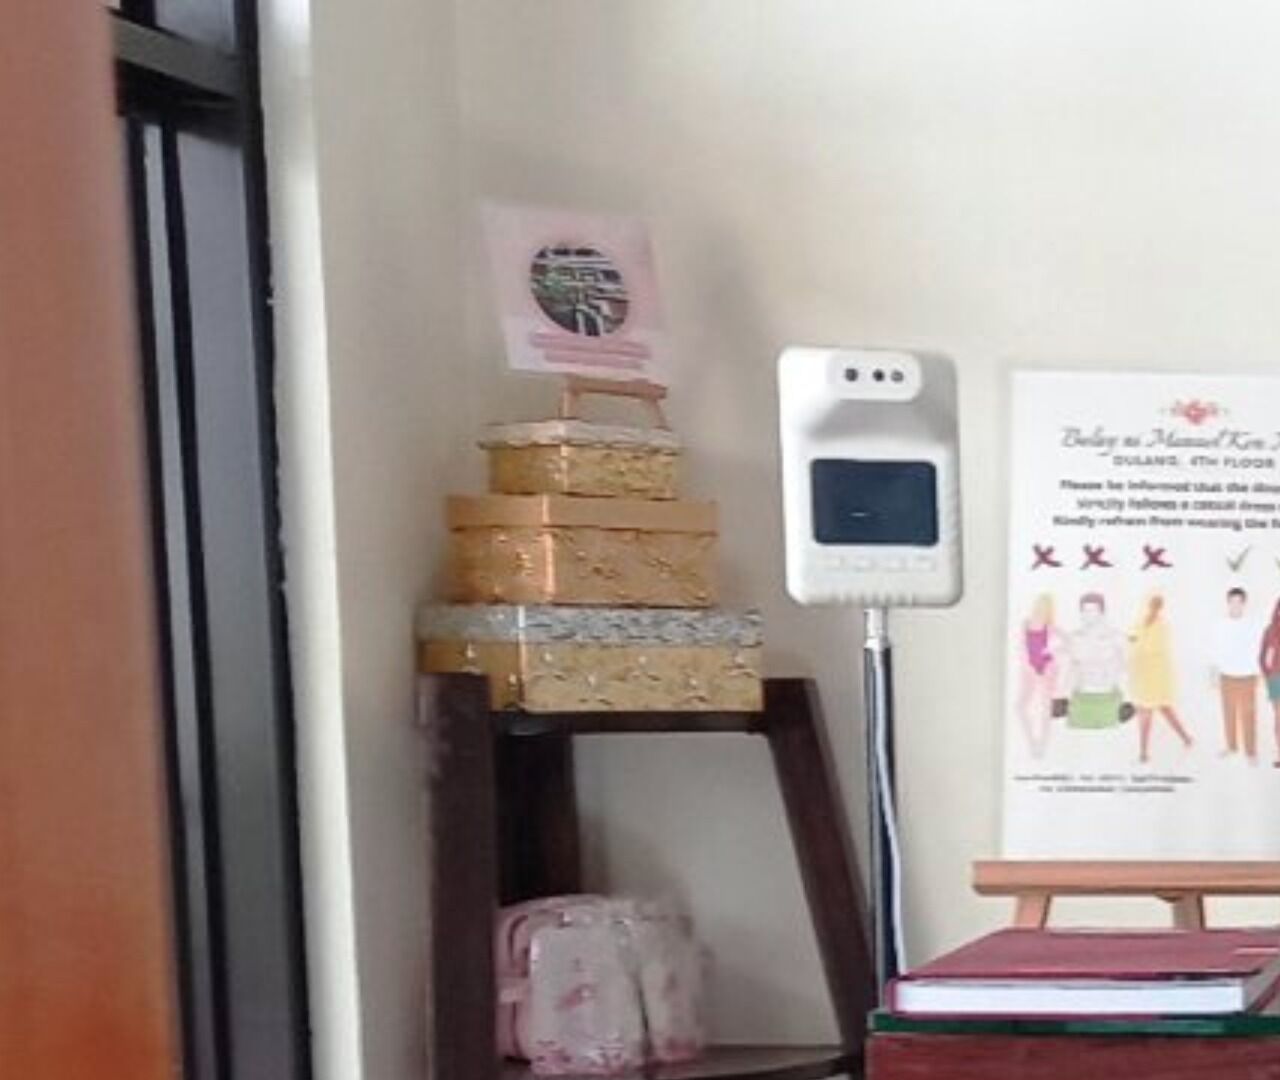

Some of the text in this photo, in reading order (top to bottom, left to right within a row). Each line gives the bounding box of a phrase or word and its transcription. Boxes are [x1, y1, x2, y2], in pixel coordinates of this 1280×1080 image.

[1224, 457, 1276, 468] FLOOR
[1060, 479, 1102, 491] Please
[1107, 480, 1123, 491] be
[1128, 480, 1190, 492] informed
[1194, 482, 1222, 493] that
[1227, 483, 1248, 493] the
[1128, 499, 1177, 510] follows
[1239, 500, 1275, 511] dress
[1053, 516, 1095, 528] Kindly
[1100, 516, 1146, 526] refrain
[1151, 516, 1183, 527] from
[1188, 517, 1242, 530] wearing
[1245, 518, 1267, 529] the
